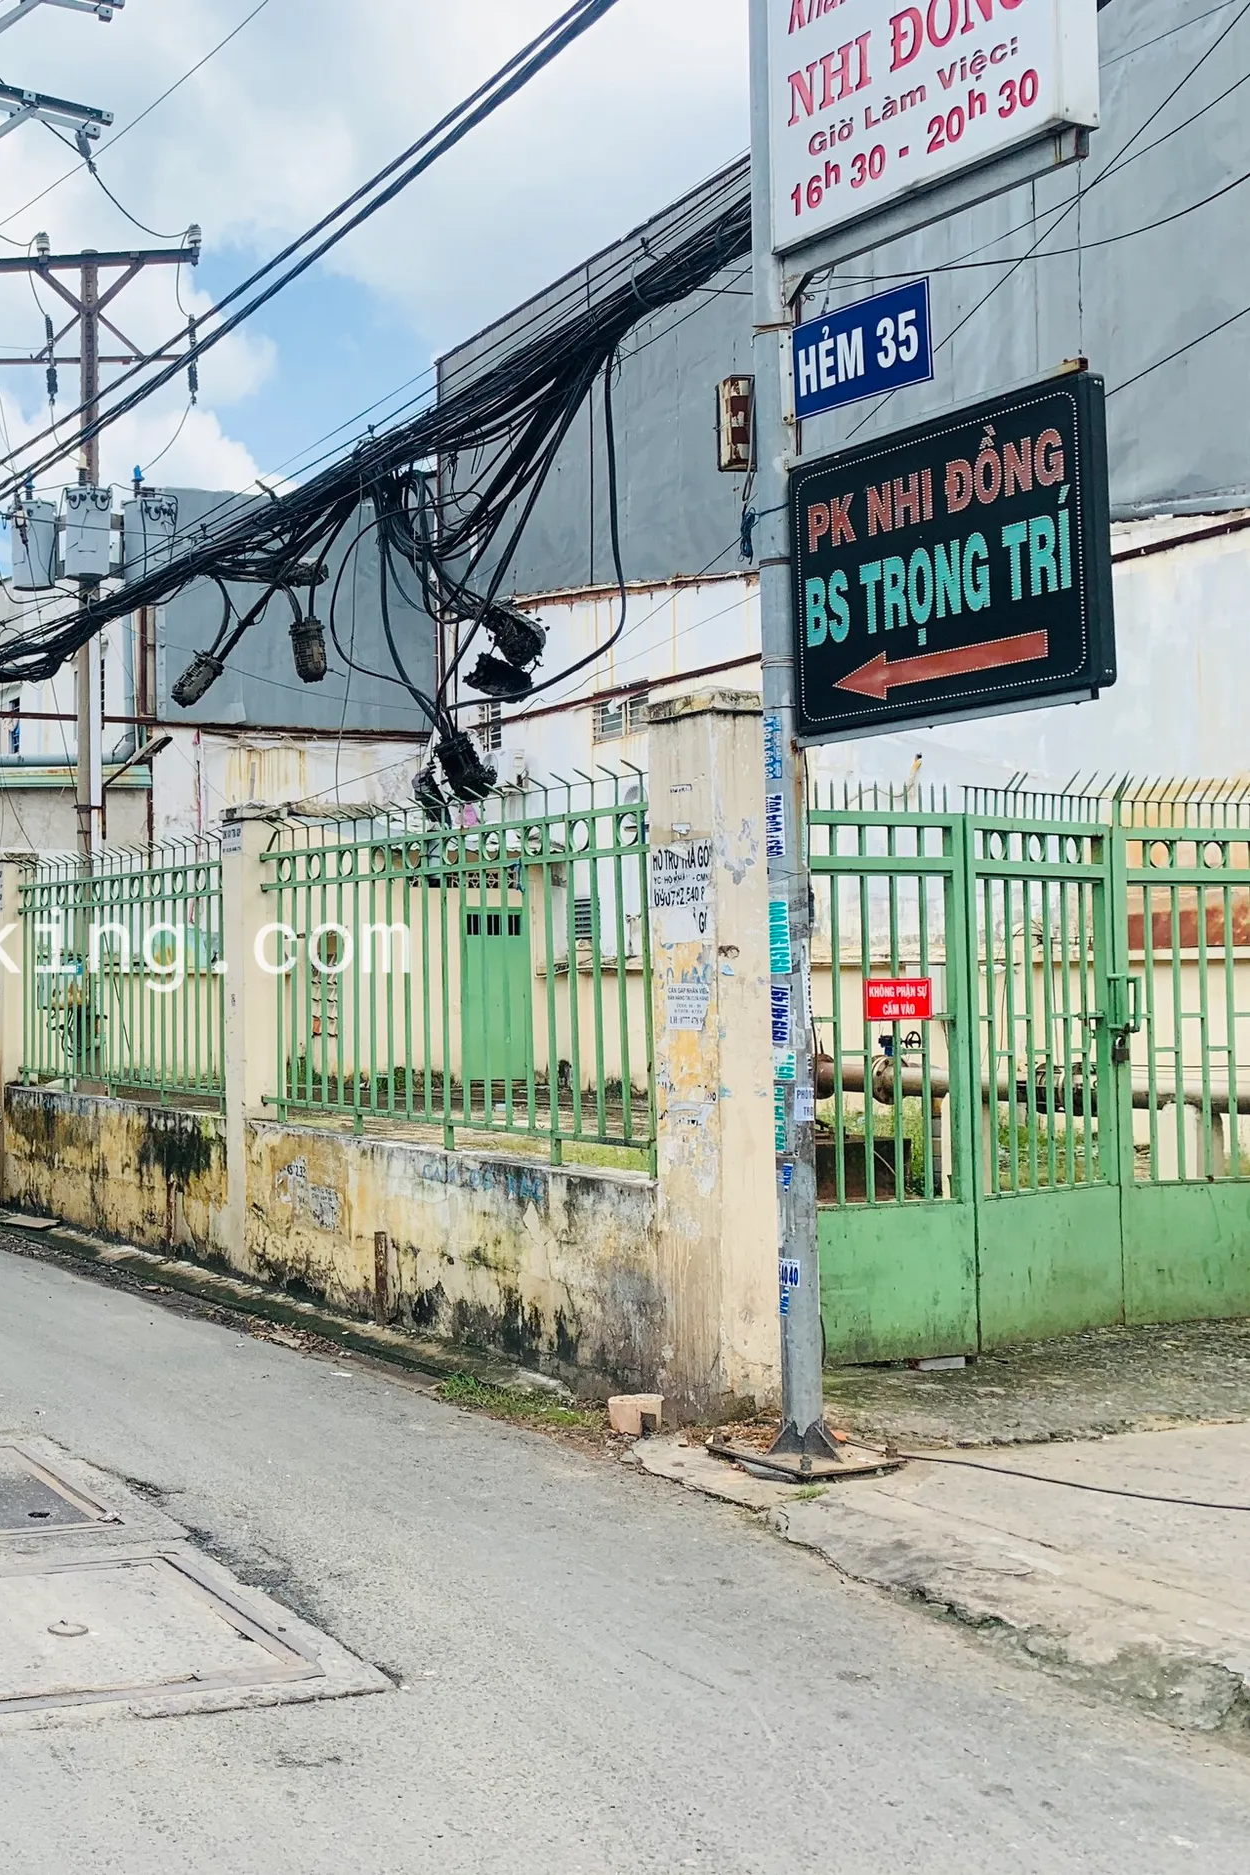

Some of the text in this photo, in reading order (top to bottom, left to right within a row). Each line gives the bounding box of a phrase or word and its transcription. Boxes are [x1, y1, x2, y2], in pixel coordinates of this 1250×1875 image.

[788, 30, 872, 127] NHI
[808, 36, 1019, 156] Giờ Làm Việc:
[790, 160, 841, 217] 16h
[850, 143, 886, 189] 30
[926, 89, 987, 154] 20h
[997, 68, 1040, 119] 30
[797, 309, 919, 397] HẺM 35
[807, 424, 1065, 553] PK NHI ĐỒNG
[805, 484, 1073, 648] BS TRỌNG TRÍ
[868, 983, 927, 999] KHÔNG PHẬN SỰ
[882, 1000, 915, 1015] CẤM VÀO
